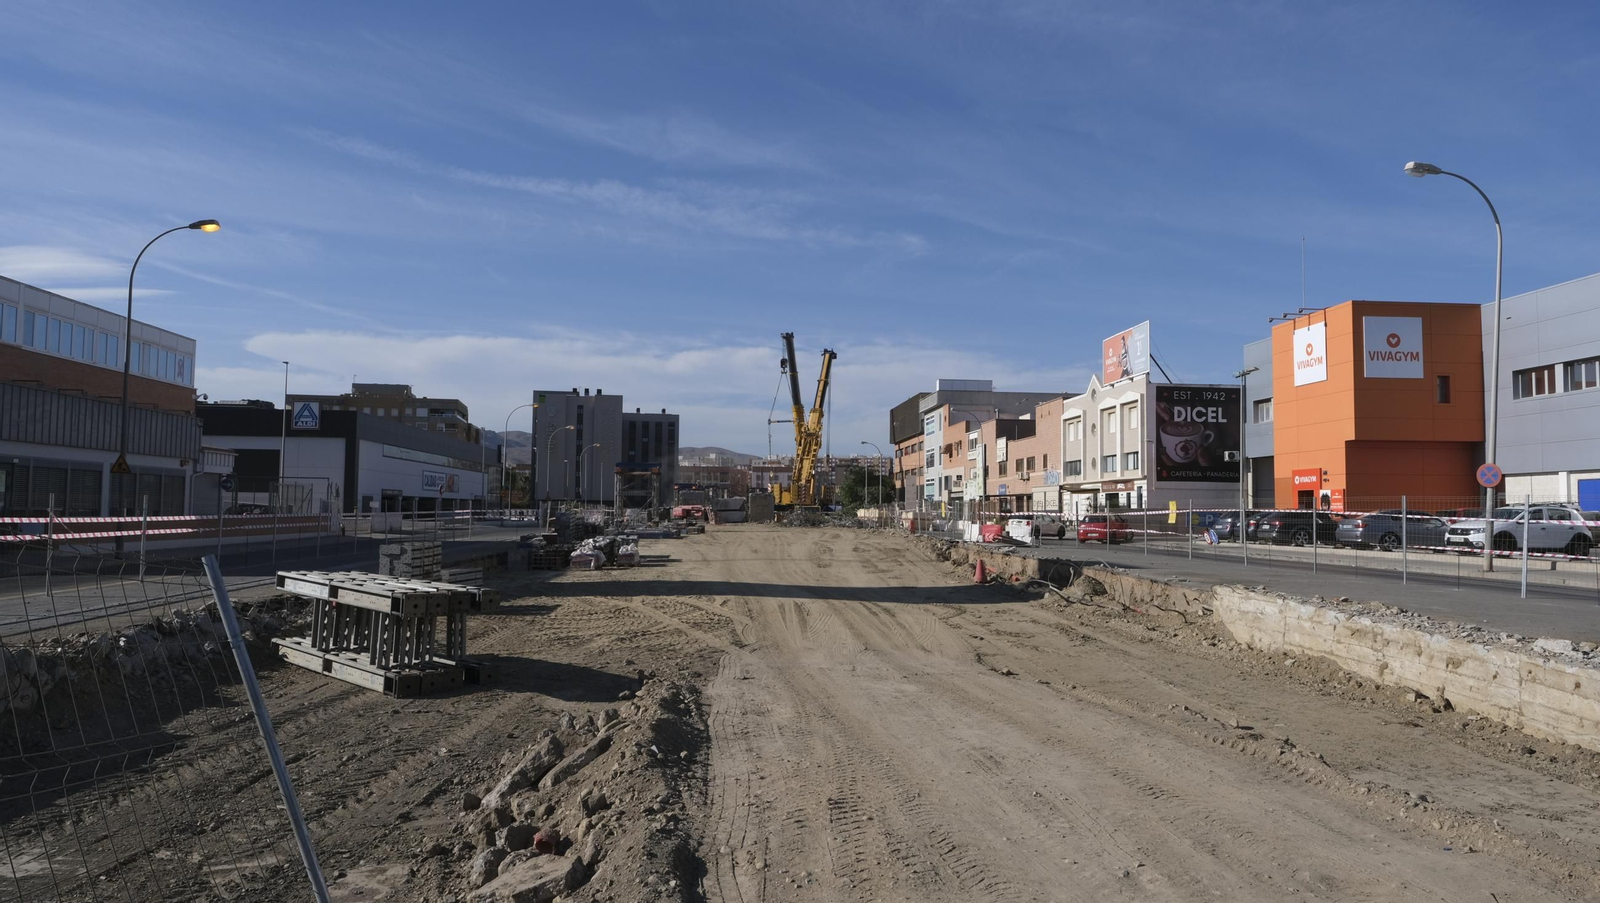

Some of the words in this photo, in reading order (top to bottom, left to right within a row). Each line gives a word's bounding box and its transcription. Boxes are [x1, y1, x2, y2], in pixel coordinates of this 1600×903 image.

[1368, 350, 1420, 362] VIVAGYM
[1297, 356, 1323, 370] VIVAGYM
[1174, 391, 1192, 400] EST
[1202, 392, 1226, 400] 1942
[1174, 406, 1228, 422] DICEL
